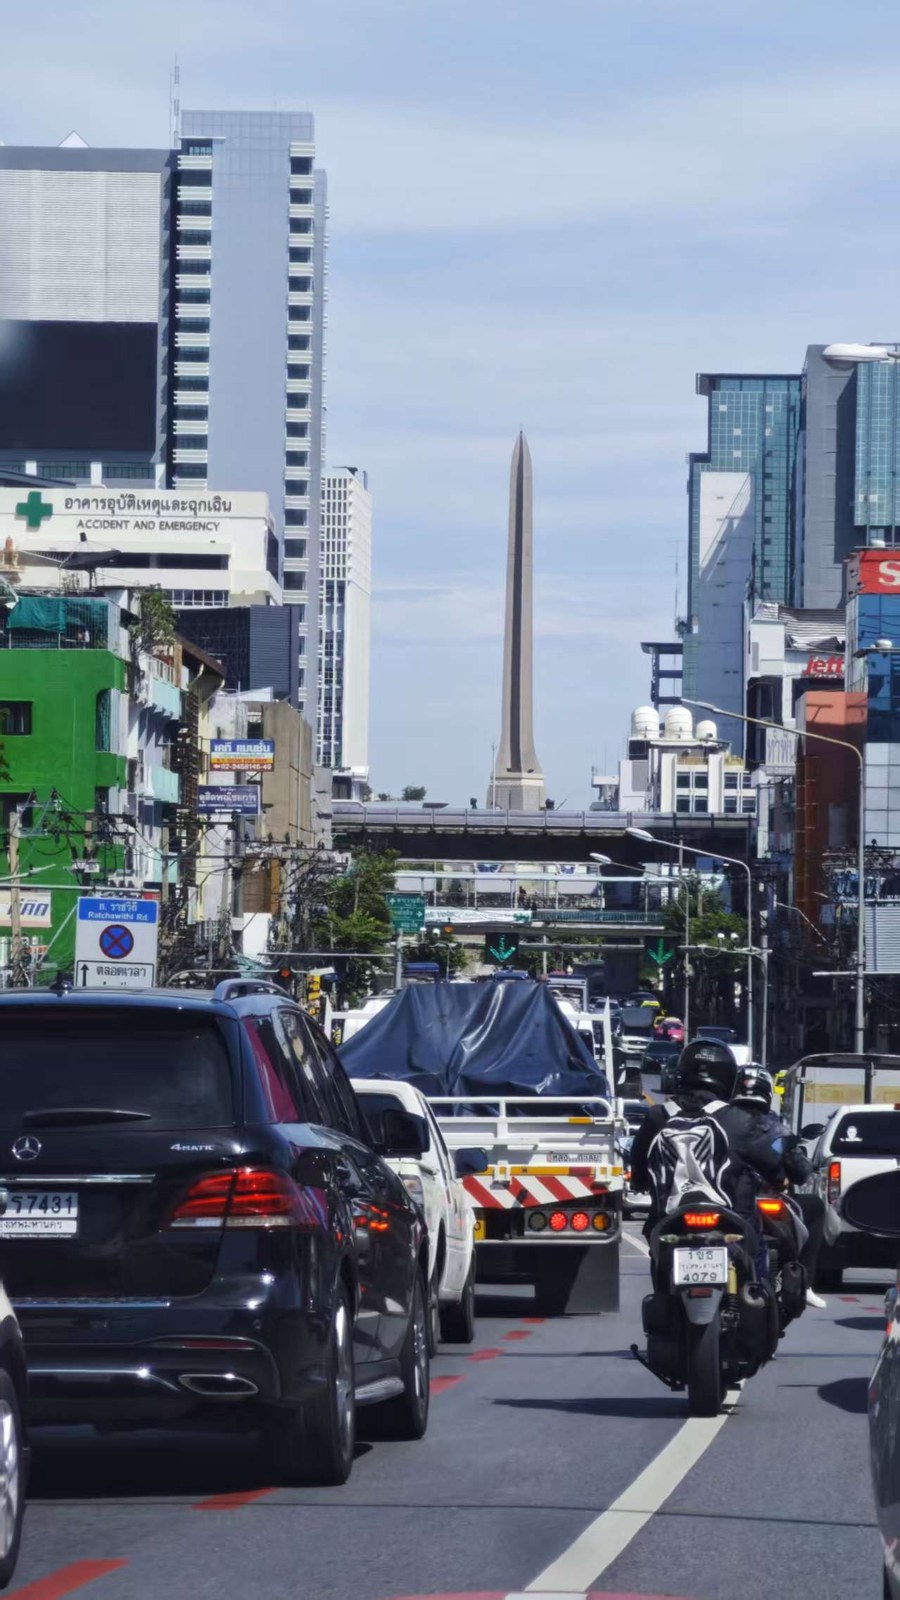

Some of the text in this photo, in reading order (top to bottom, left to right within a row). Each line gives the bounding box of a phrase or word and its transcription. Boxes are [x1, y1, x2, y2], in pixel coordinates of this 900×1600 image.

[64, 494, 232, 516] อาคารอุบัติเหตุและฉุกเฉิน
[77, 519, 220, 532] ACCIDENT AND EMERGENCY
[88, 911, 133, 920] Ratchawithi
[96, 966, 146, 977] ตลอดเวลา
[170, 1143, 215, 1151] 4MATIC
[682, 1272, 717, 1282] 4079
